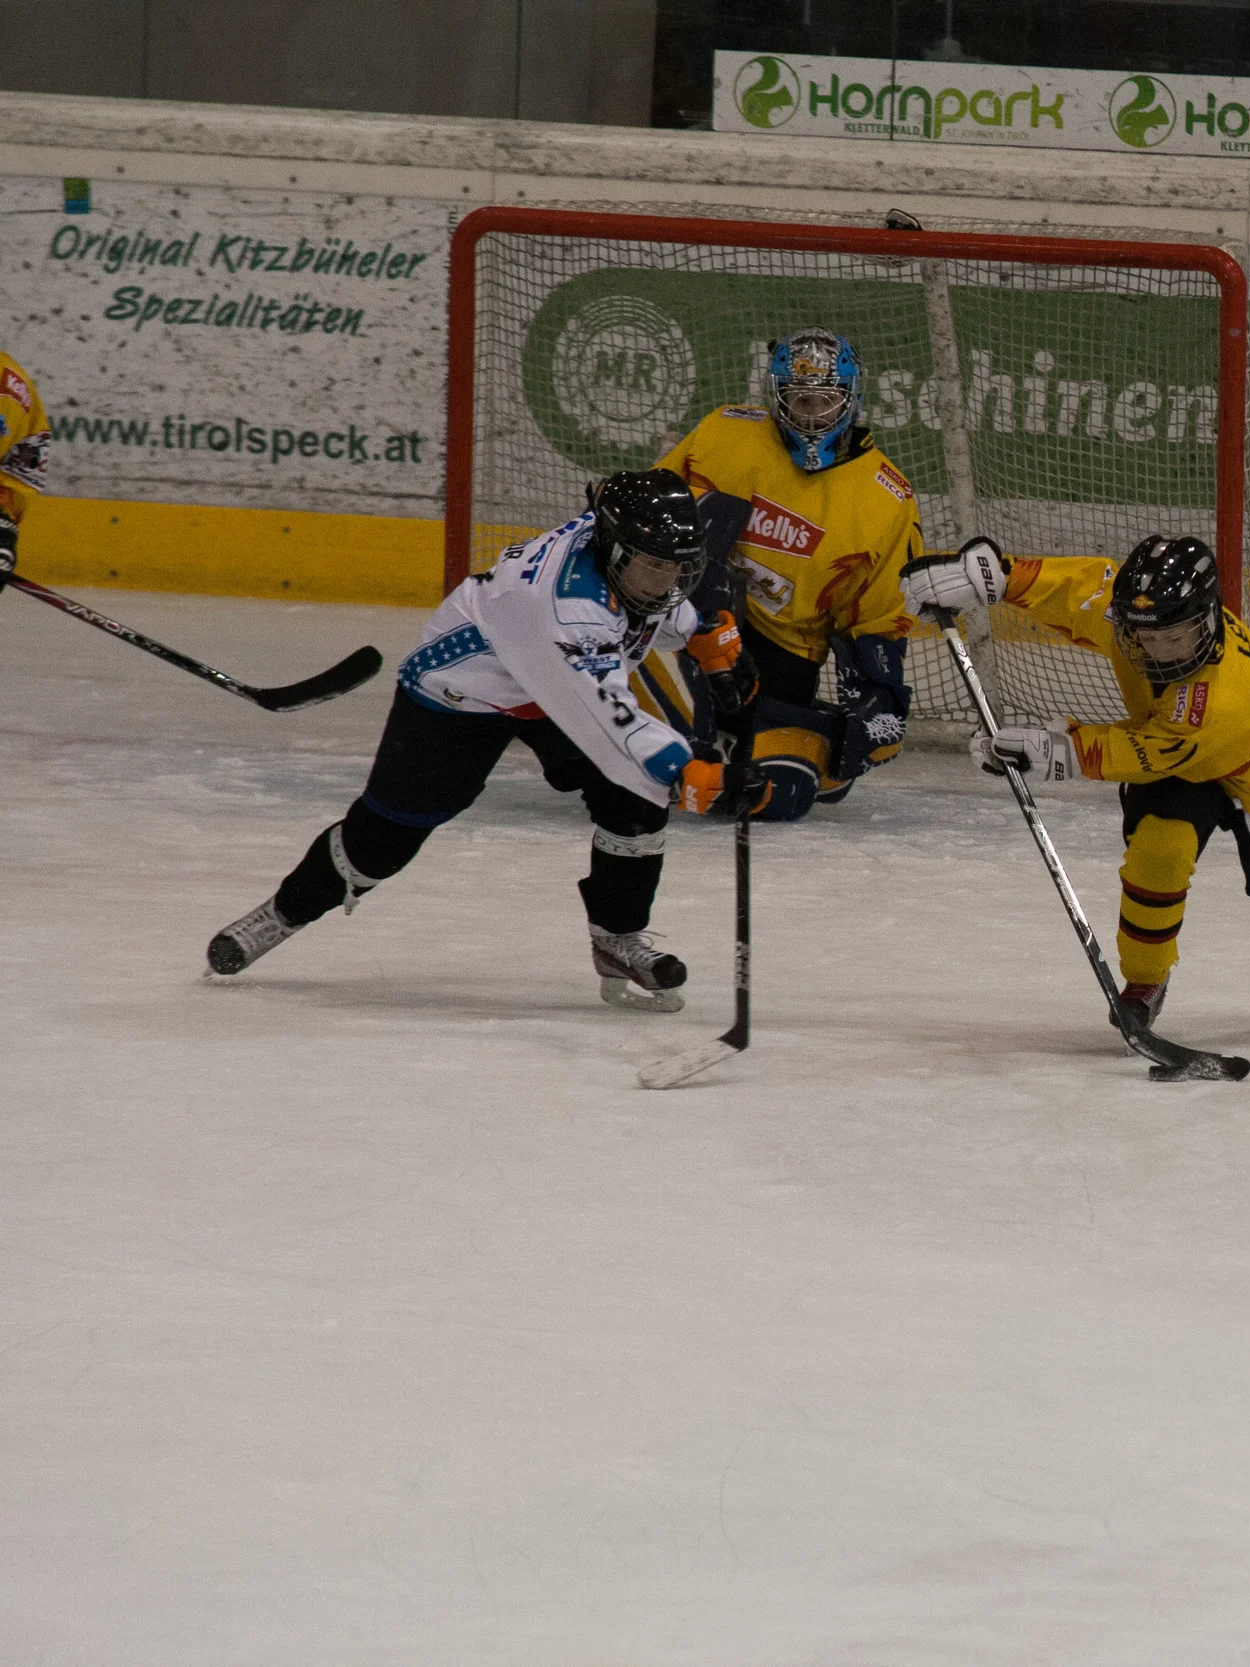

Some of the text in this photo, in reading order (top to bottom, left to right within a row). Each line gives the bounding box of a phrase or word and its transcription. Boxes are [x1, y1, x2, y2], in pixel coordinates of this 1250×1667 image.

[809, 73, 1064, 138] Hornpark
[50, 224, 426, 280] Original Kitzbüheler
[105, 286, 367, 337] Spezialitäten
[48, 415, 423, 464] www.tirolspeck.at
[976, 556, 997, 605] Baue
[1127, 611, 1158, 622] Reebok
